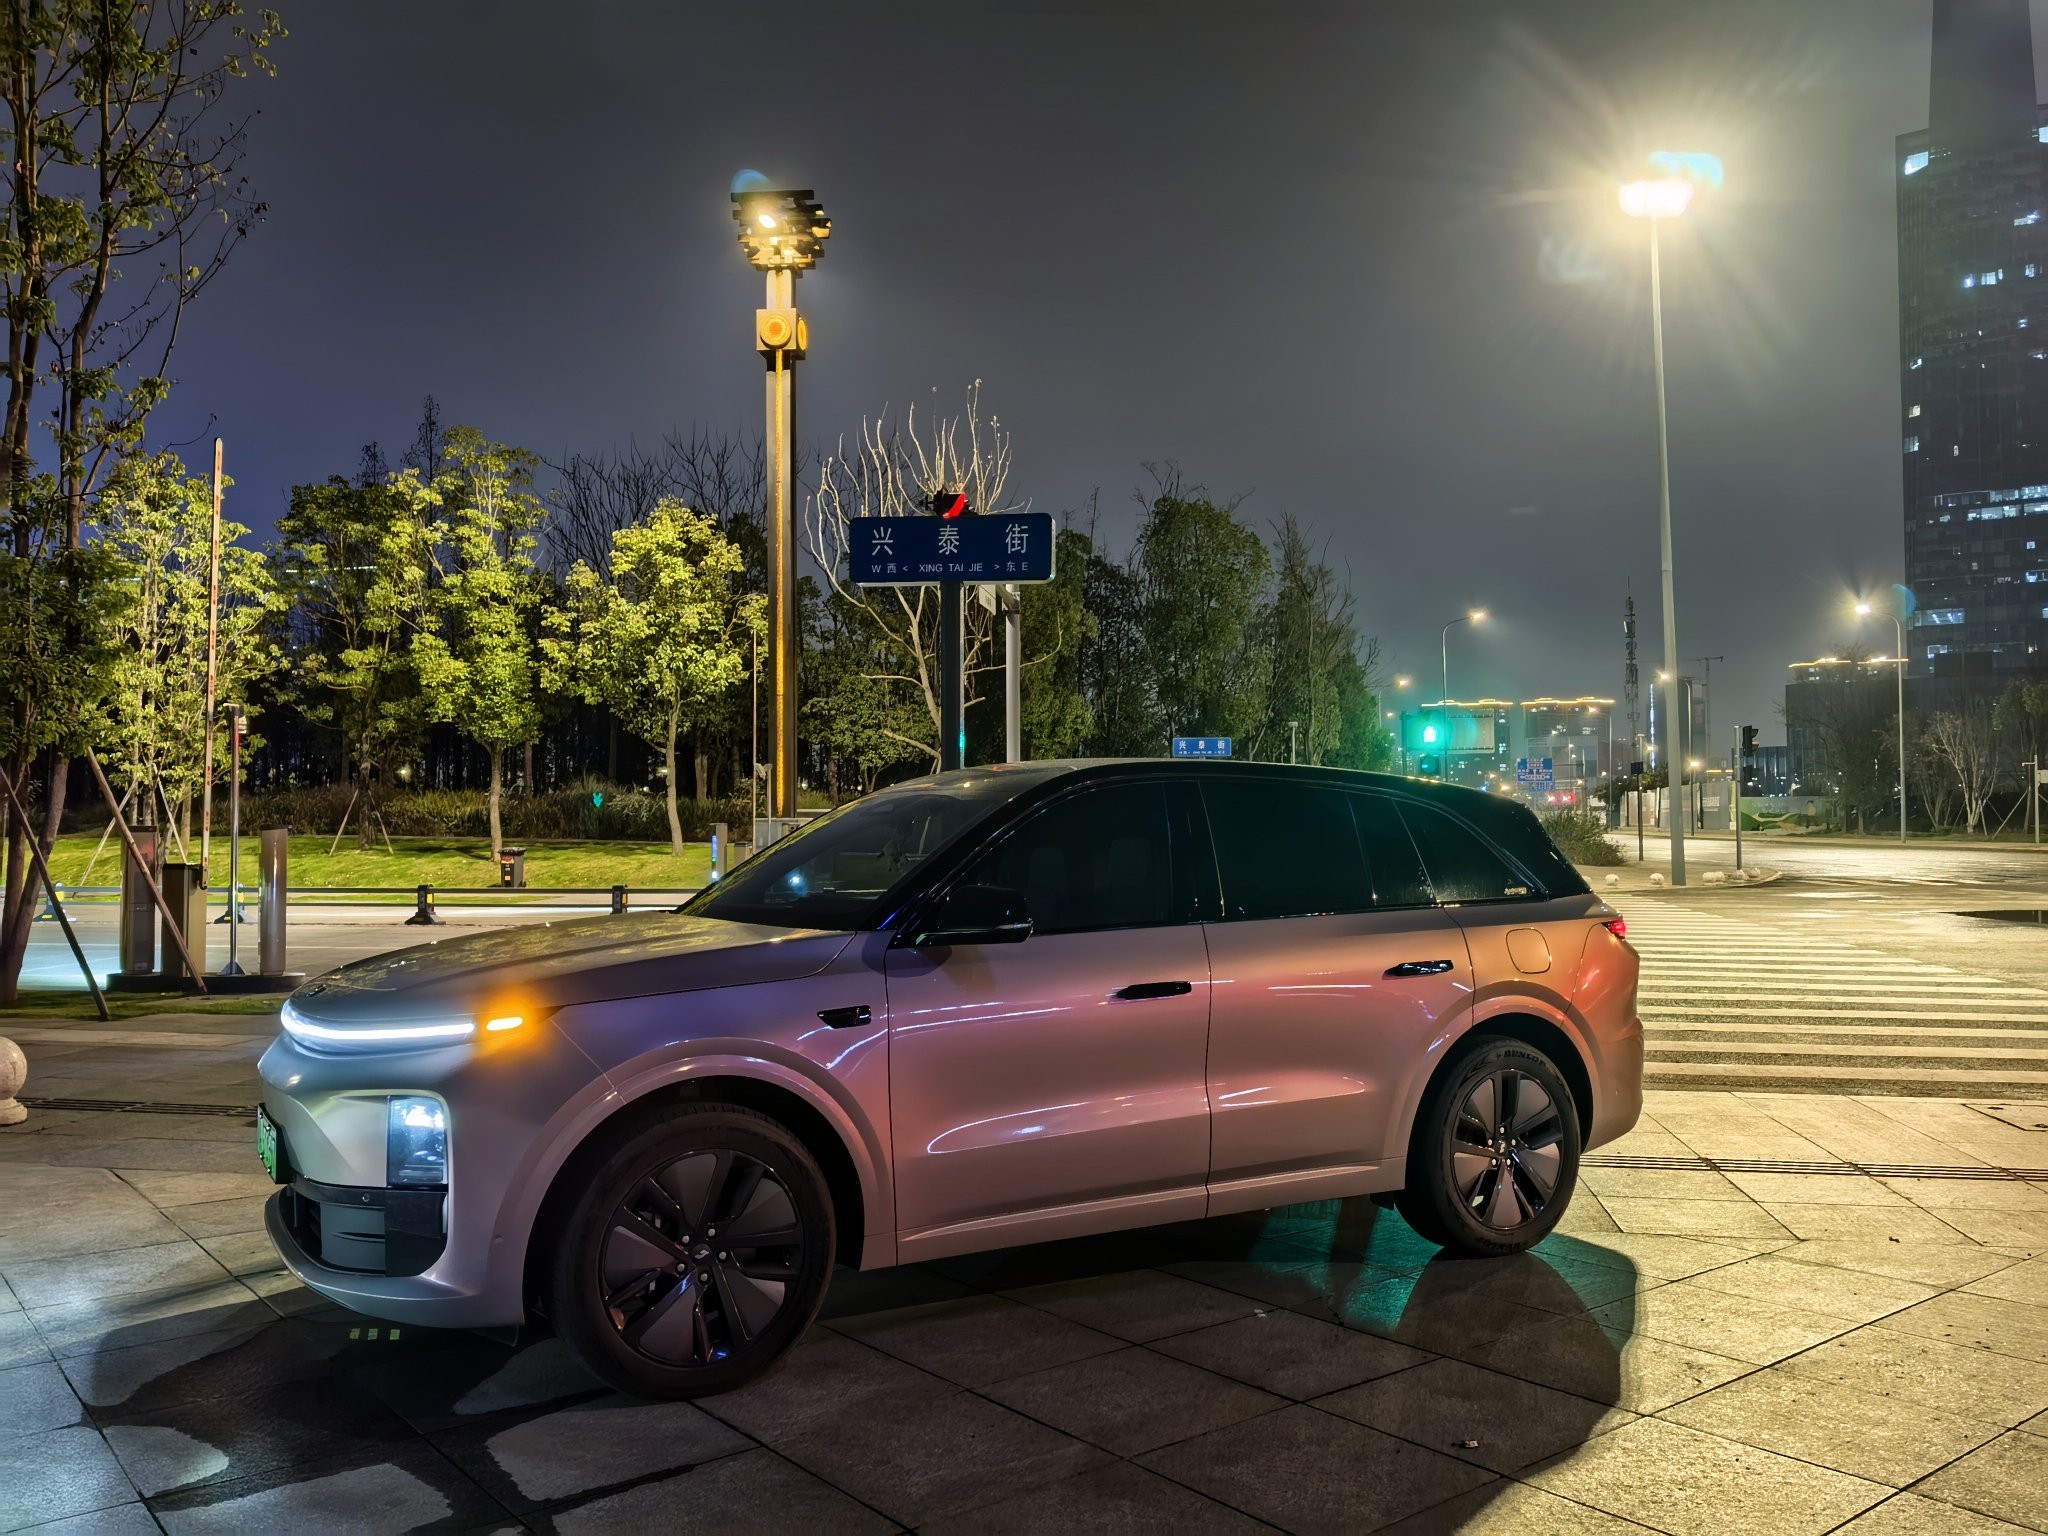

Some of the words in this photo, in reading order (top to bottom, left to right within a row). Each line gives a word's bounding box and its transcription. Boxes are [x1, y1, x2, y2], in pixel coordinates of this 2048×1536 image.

[871, 524, 1029, 555] 兴泰街
[871, 564, 882, 573] W
[887, 563, 897, 574] 西
[919, 563, 943, 573] XING
[948, 563, 964, 572] TAI
[968, 562, 983, 572] JIE
[1006, 560, 1016, 572] 东
[1021, 562, 1029, 571] E
